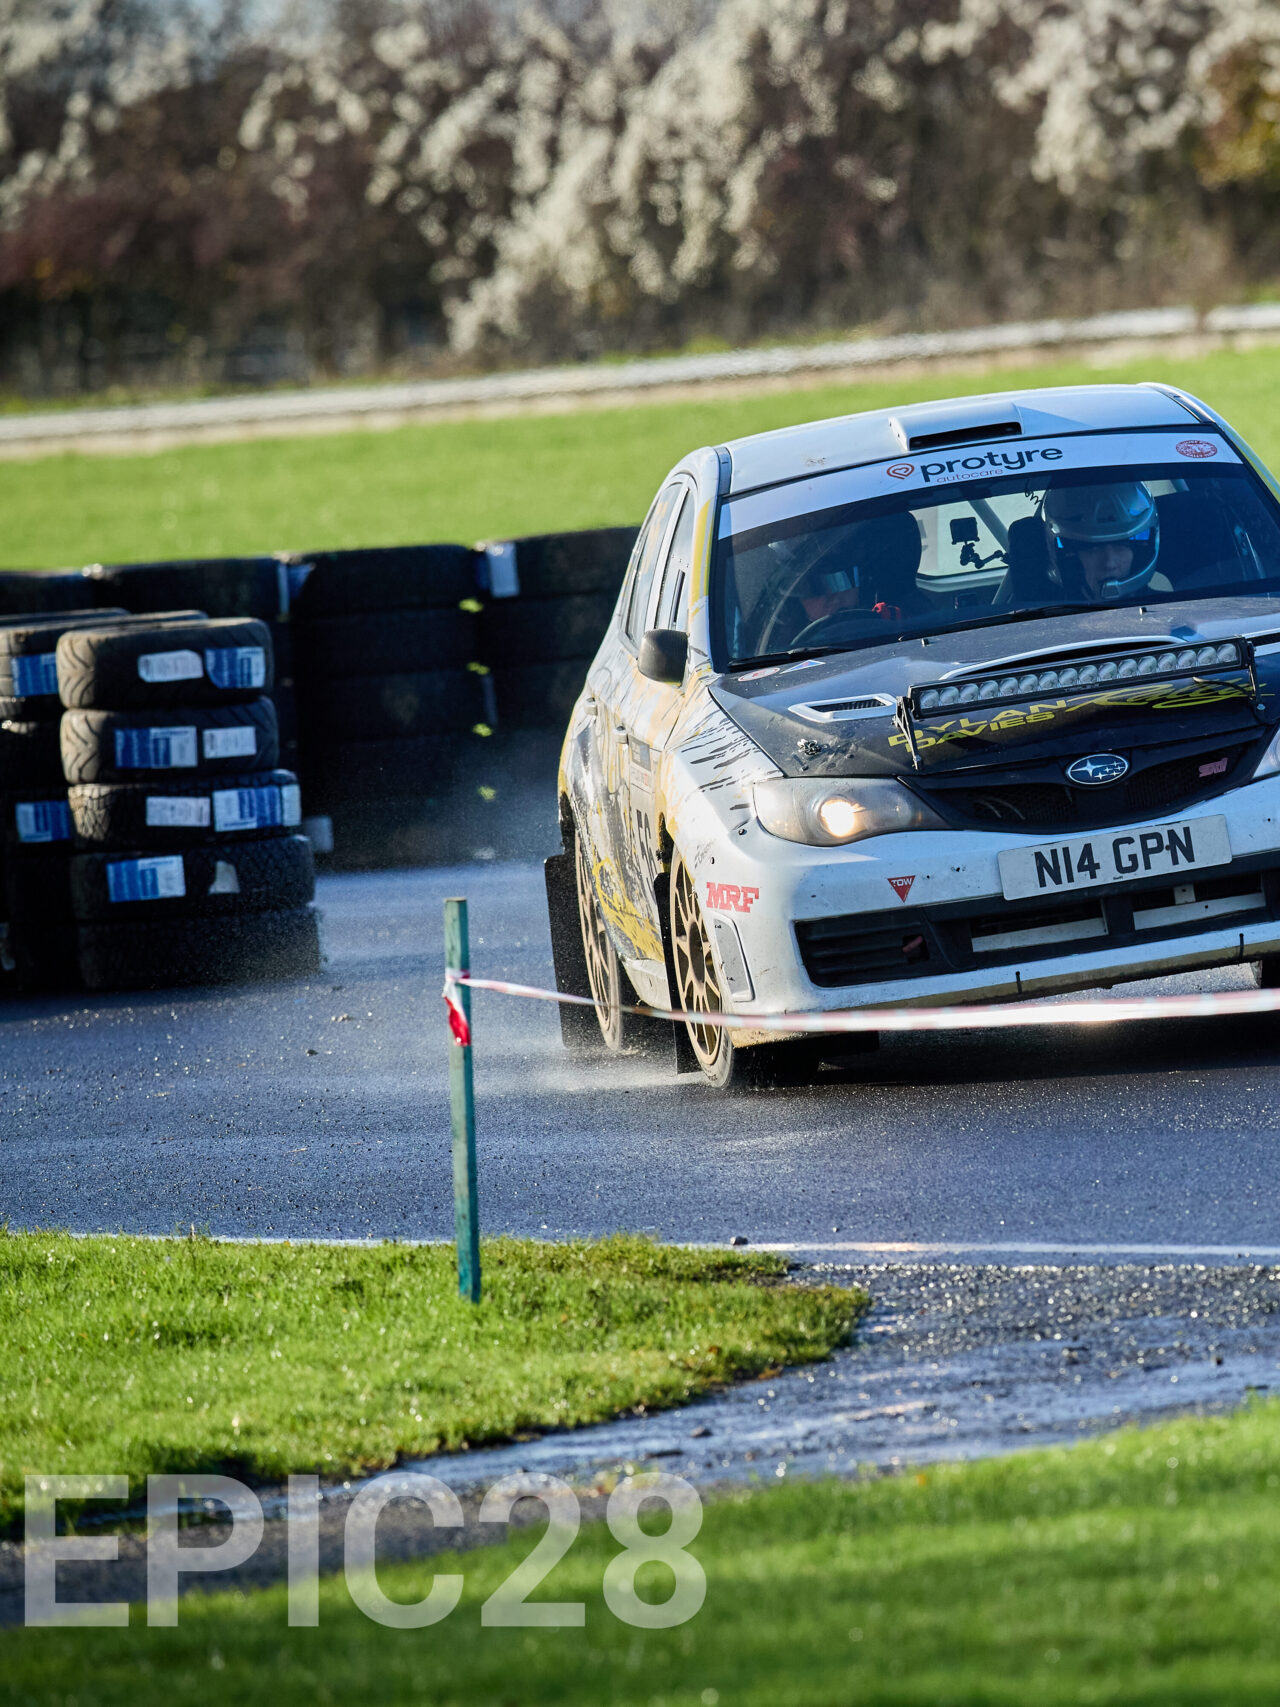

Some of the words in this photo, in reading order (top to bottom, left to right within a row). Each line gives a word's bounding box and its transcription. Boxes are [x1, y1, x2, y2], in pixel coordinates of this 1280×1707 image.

[920, 447, 1064, 482] protyre
[936, 468, 1003, 483] autocare
[887, 699, 1068, 747] DYLAN
[905, 711, 1056, 753] DAVIES
[1034, 842, 1100, 888] N14
[1112, 826, 1195, 874] GPN
[706, 881, 760, 913] MRF
[891, 877, 913, 888] TOW
